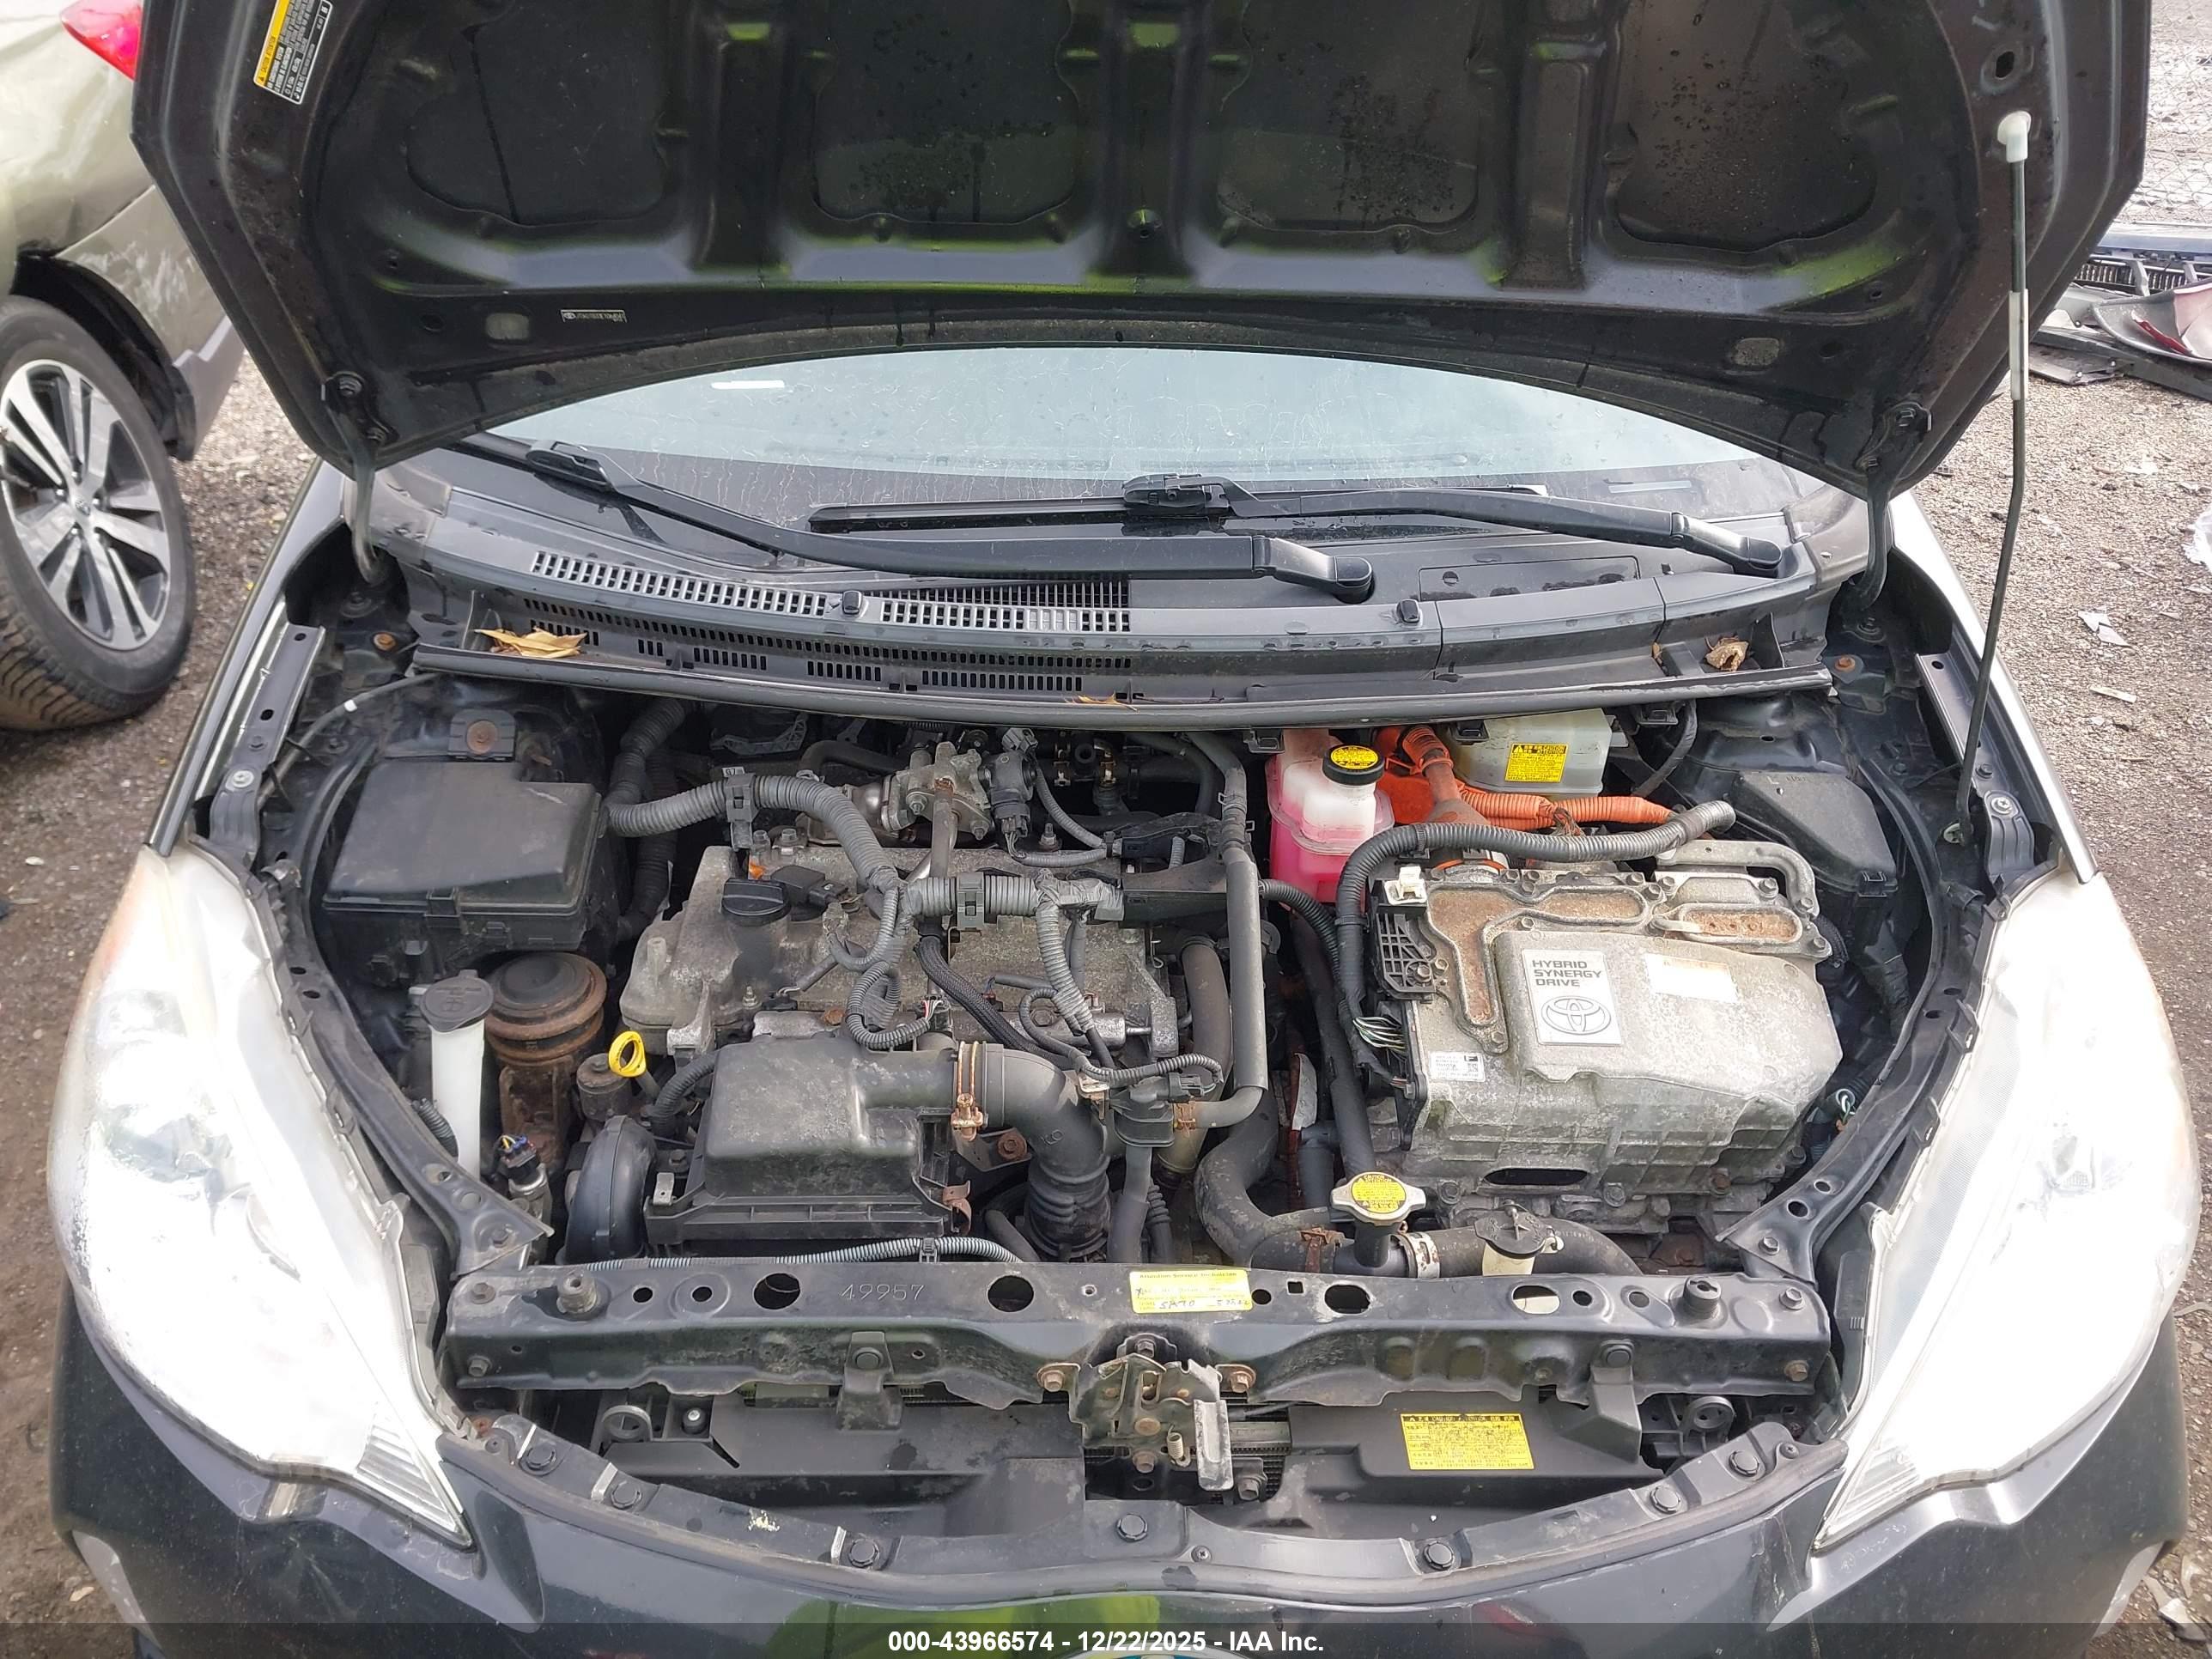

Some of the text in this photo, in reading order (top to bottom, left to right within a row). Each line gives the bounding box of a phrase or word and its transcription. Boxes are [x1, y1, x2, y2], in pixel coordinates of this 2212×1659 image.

[1532, 960, 1588, 969] HYBRID
[1534, 969, 1601, 978] SYNERGY
[1535, 978, 1580, 987] DRIVE
[841, 1283, 925, 1301] 49957
